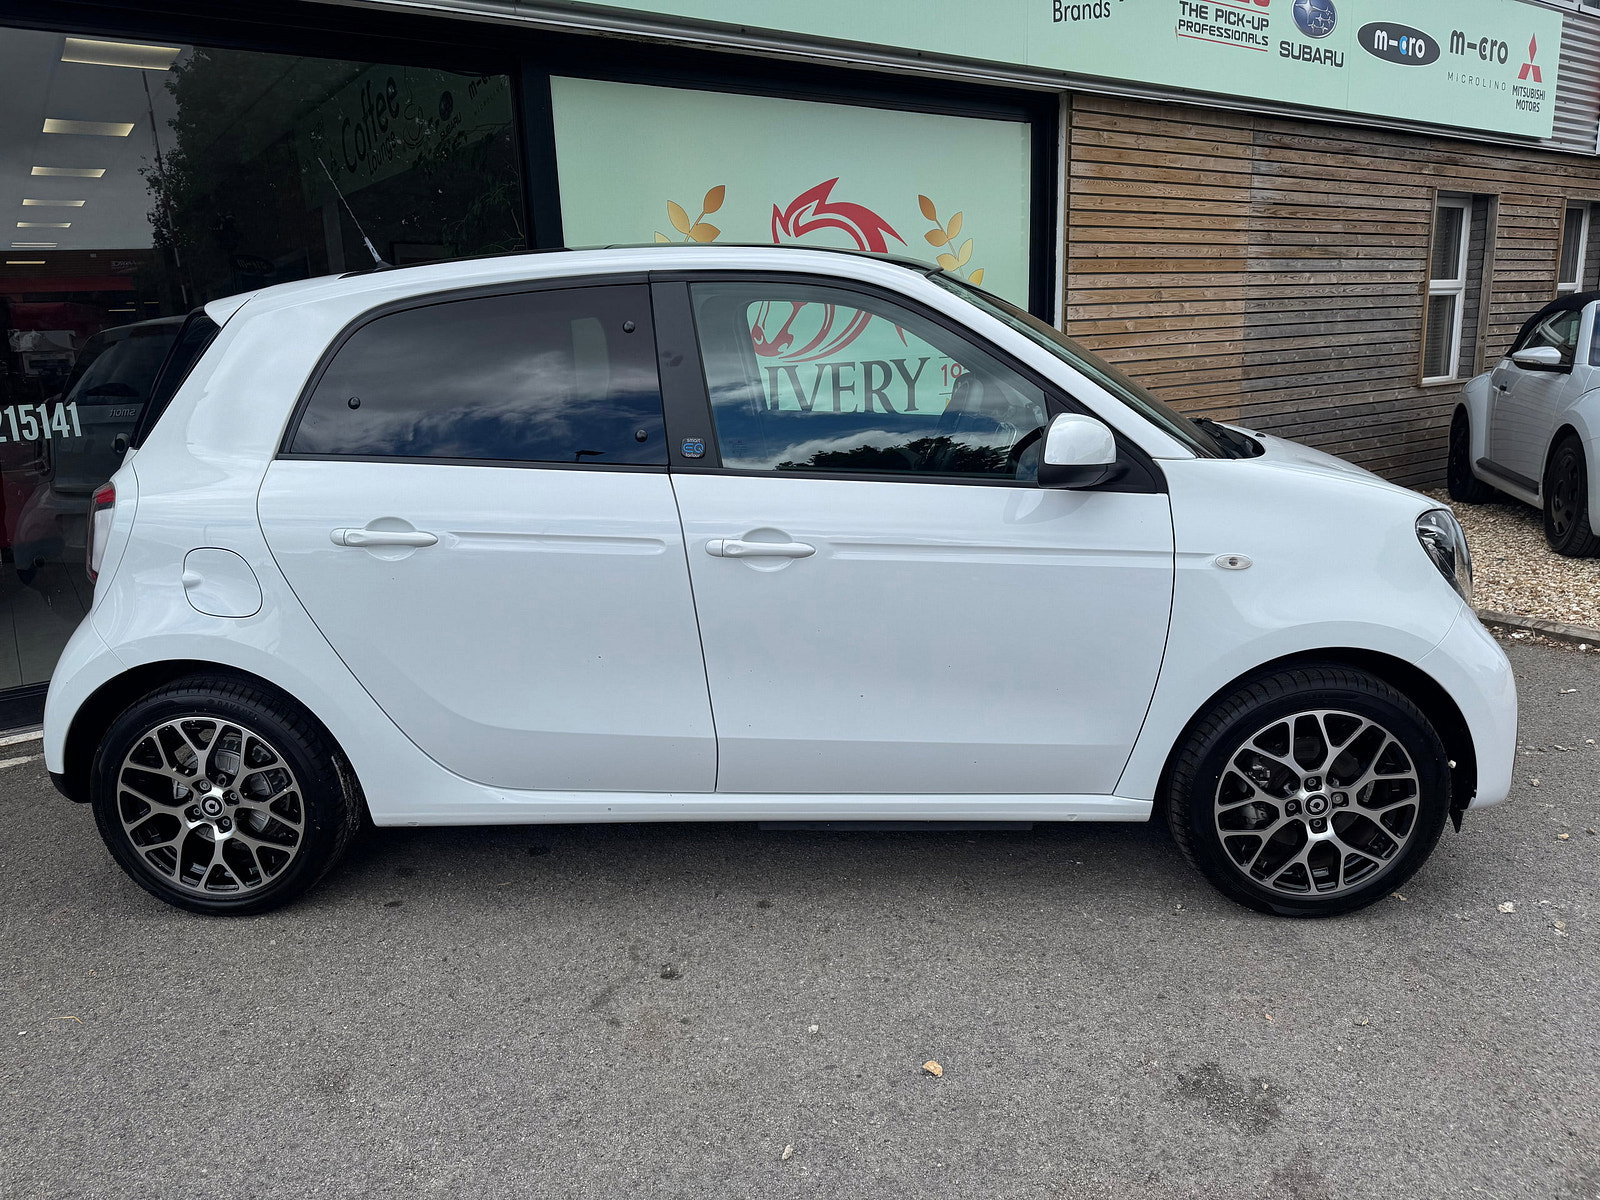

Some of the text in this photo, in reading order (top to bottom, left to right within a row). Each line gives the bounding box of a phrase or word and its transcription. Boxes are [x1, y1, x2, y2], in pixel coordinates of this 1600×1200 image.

[1053, 0, 1110, 22] Brands
[1179, 1, 1269, 32] THE PICK-UP
[1178, 19, 1269, 46] PROFESSIONALS
[1279, 40, 1344, 68] SUBARU
[1447, 71, 1506, 91] MICROLINO
[1512, 84, 1546, 101] MITSUBISHI
[1515, 99, 1540, 113] MOTORS
[341, 76, 400, 173] Coffee
